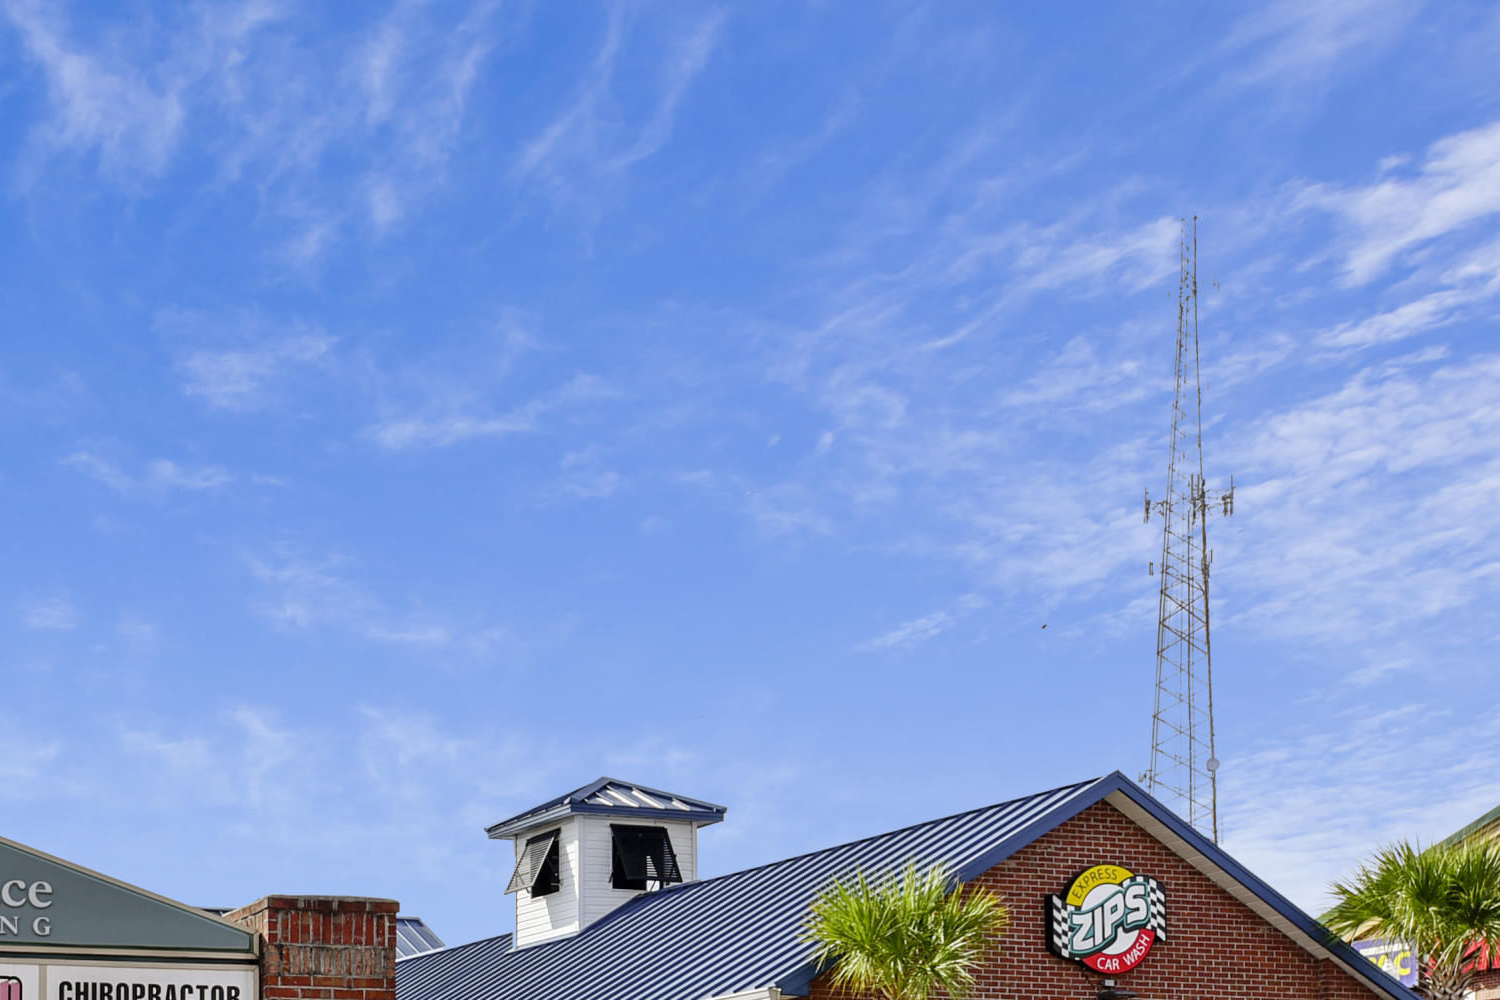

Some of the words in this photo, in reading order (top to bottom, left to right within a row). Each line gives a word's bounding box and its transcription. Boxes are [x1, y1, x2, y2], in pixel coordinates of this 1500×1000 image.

[1072, 868, 1118, 899] EXPRESS
[1072, 884, 1149, 951] ZIPS
[1097, 957, 1120, 971] CAR
[1122, 933, 1150, 966] WASH
